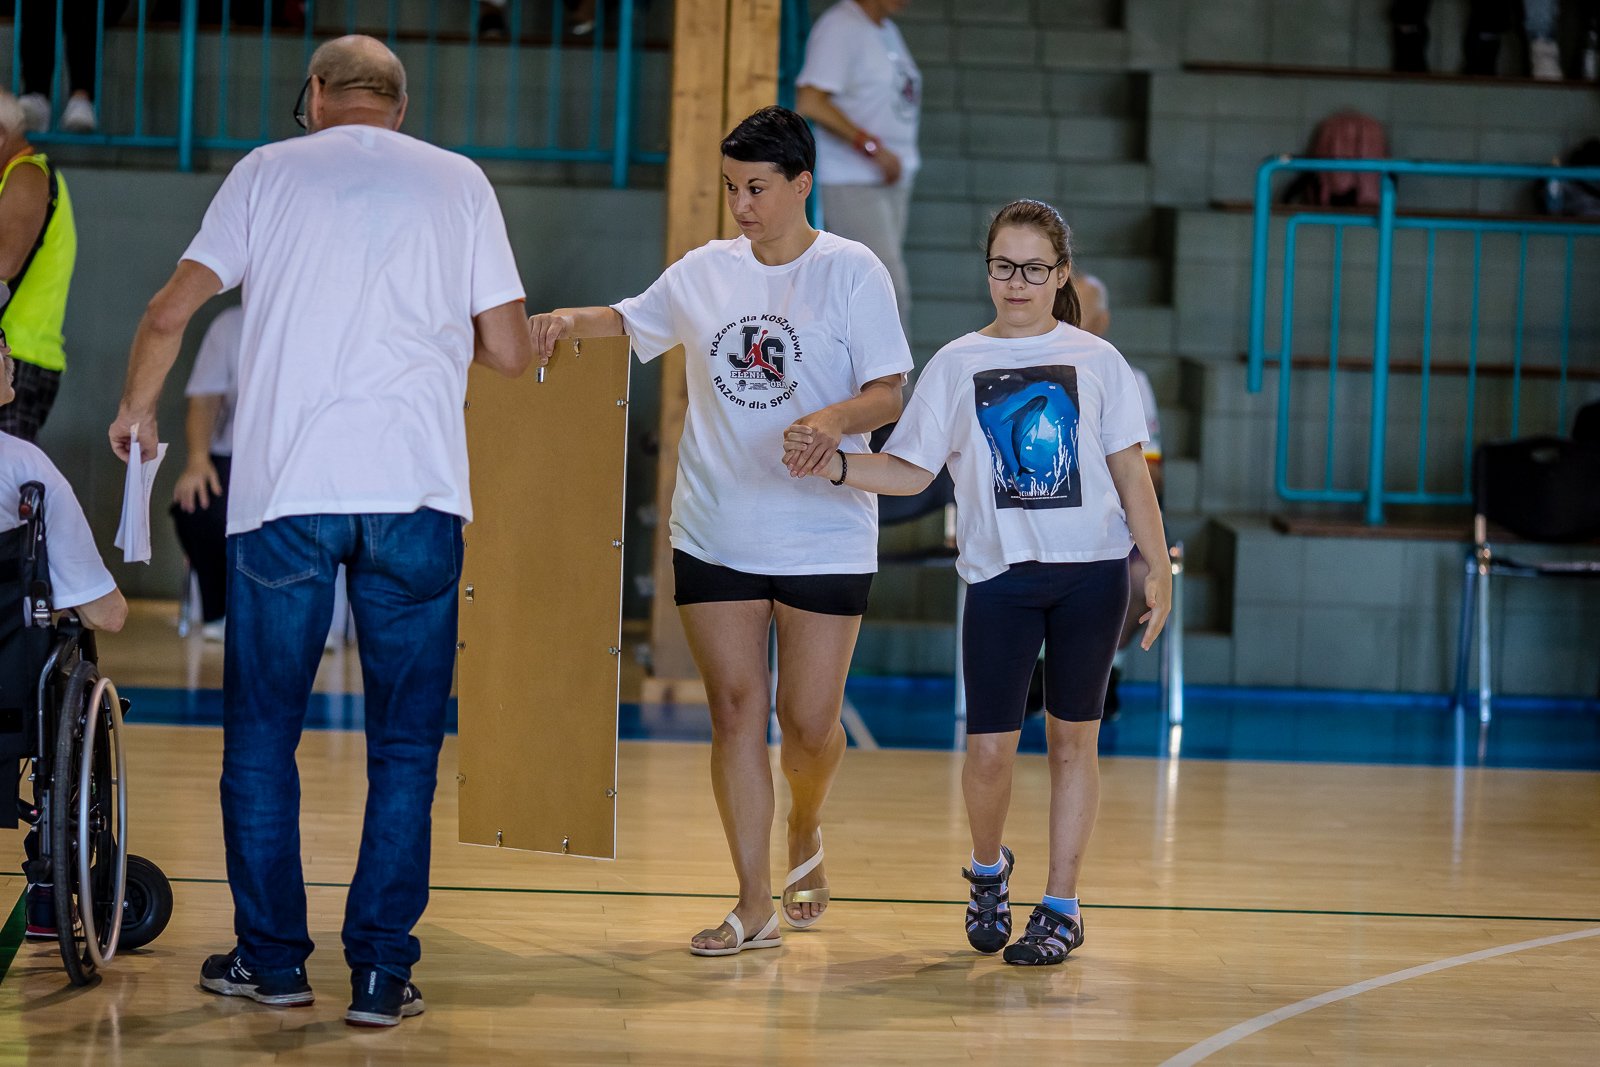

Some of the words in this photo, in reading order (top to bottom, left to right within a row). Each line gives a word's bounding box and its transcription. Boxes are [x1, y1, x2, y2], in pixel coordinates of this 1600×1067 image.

[710, 322, 736, 356] RAZem
[740, 316, 757, 324] dla
[761, 314, 803, 362] KOSZykówki
[713, 375, 746, 407] RAZem
[749, 401, 767, 410] dla
